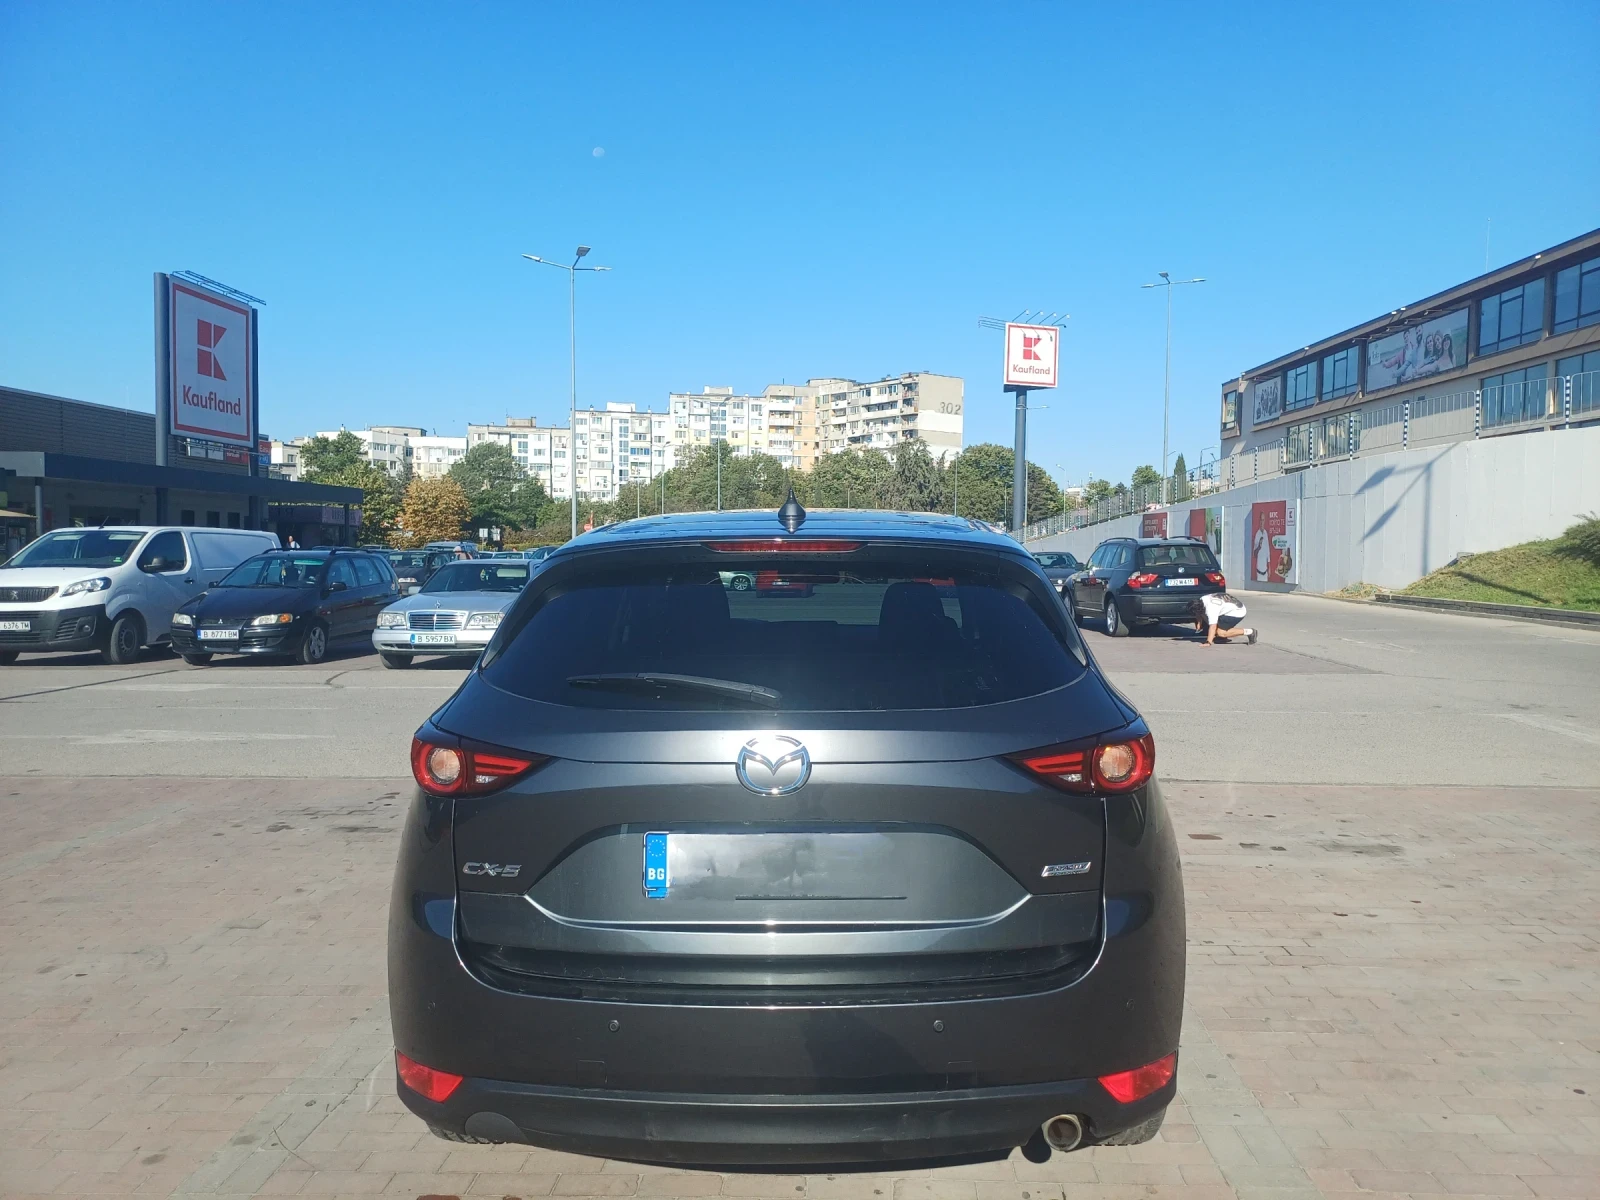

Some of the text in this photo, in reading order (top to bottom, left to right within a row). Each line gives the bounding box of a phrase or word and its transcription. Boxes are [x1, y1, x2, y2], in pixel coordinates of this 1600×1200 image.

[196, 318, 227, 381] K
[1012, 363, 1051, 375] Kaufland
[182, 384, 241, 416] Kaufland
[939, 401, 962, 415] 302
[3, 622, 20, 630] 6376
[425, 635, 443, 643] 5957
[462, 861, 522, 878] CX-5
[647, 867, 665, 880] BG
